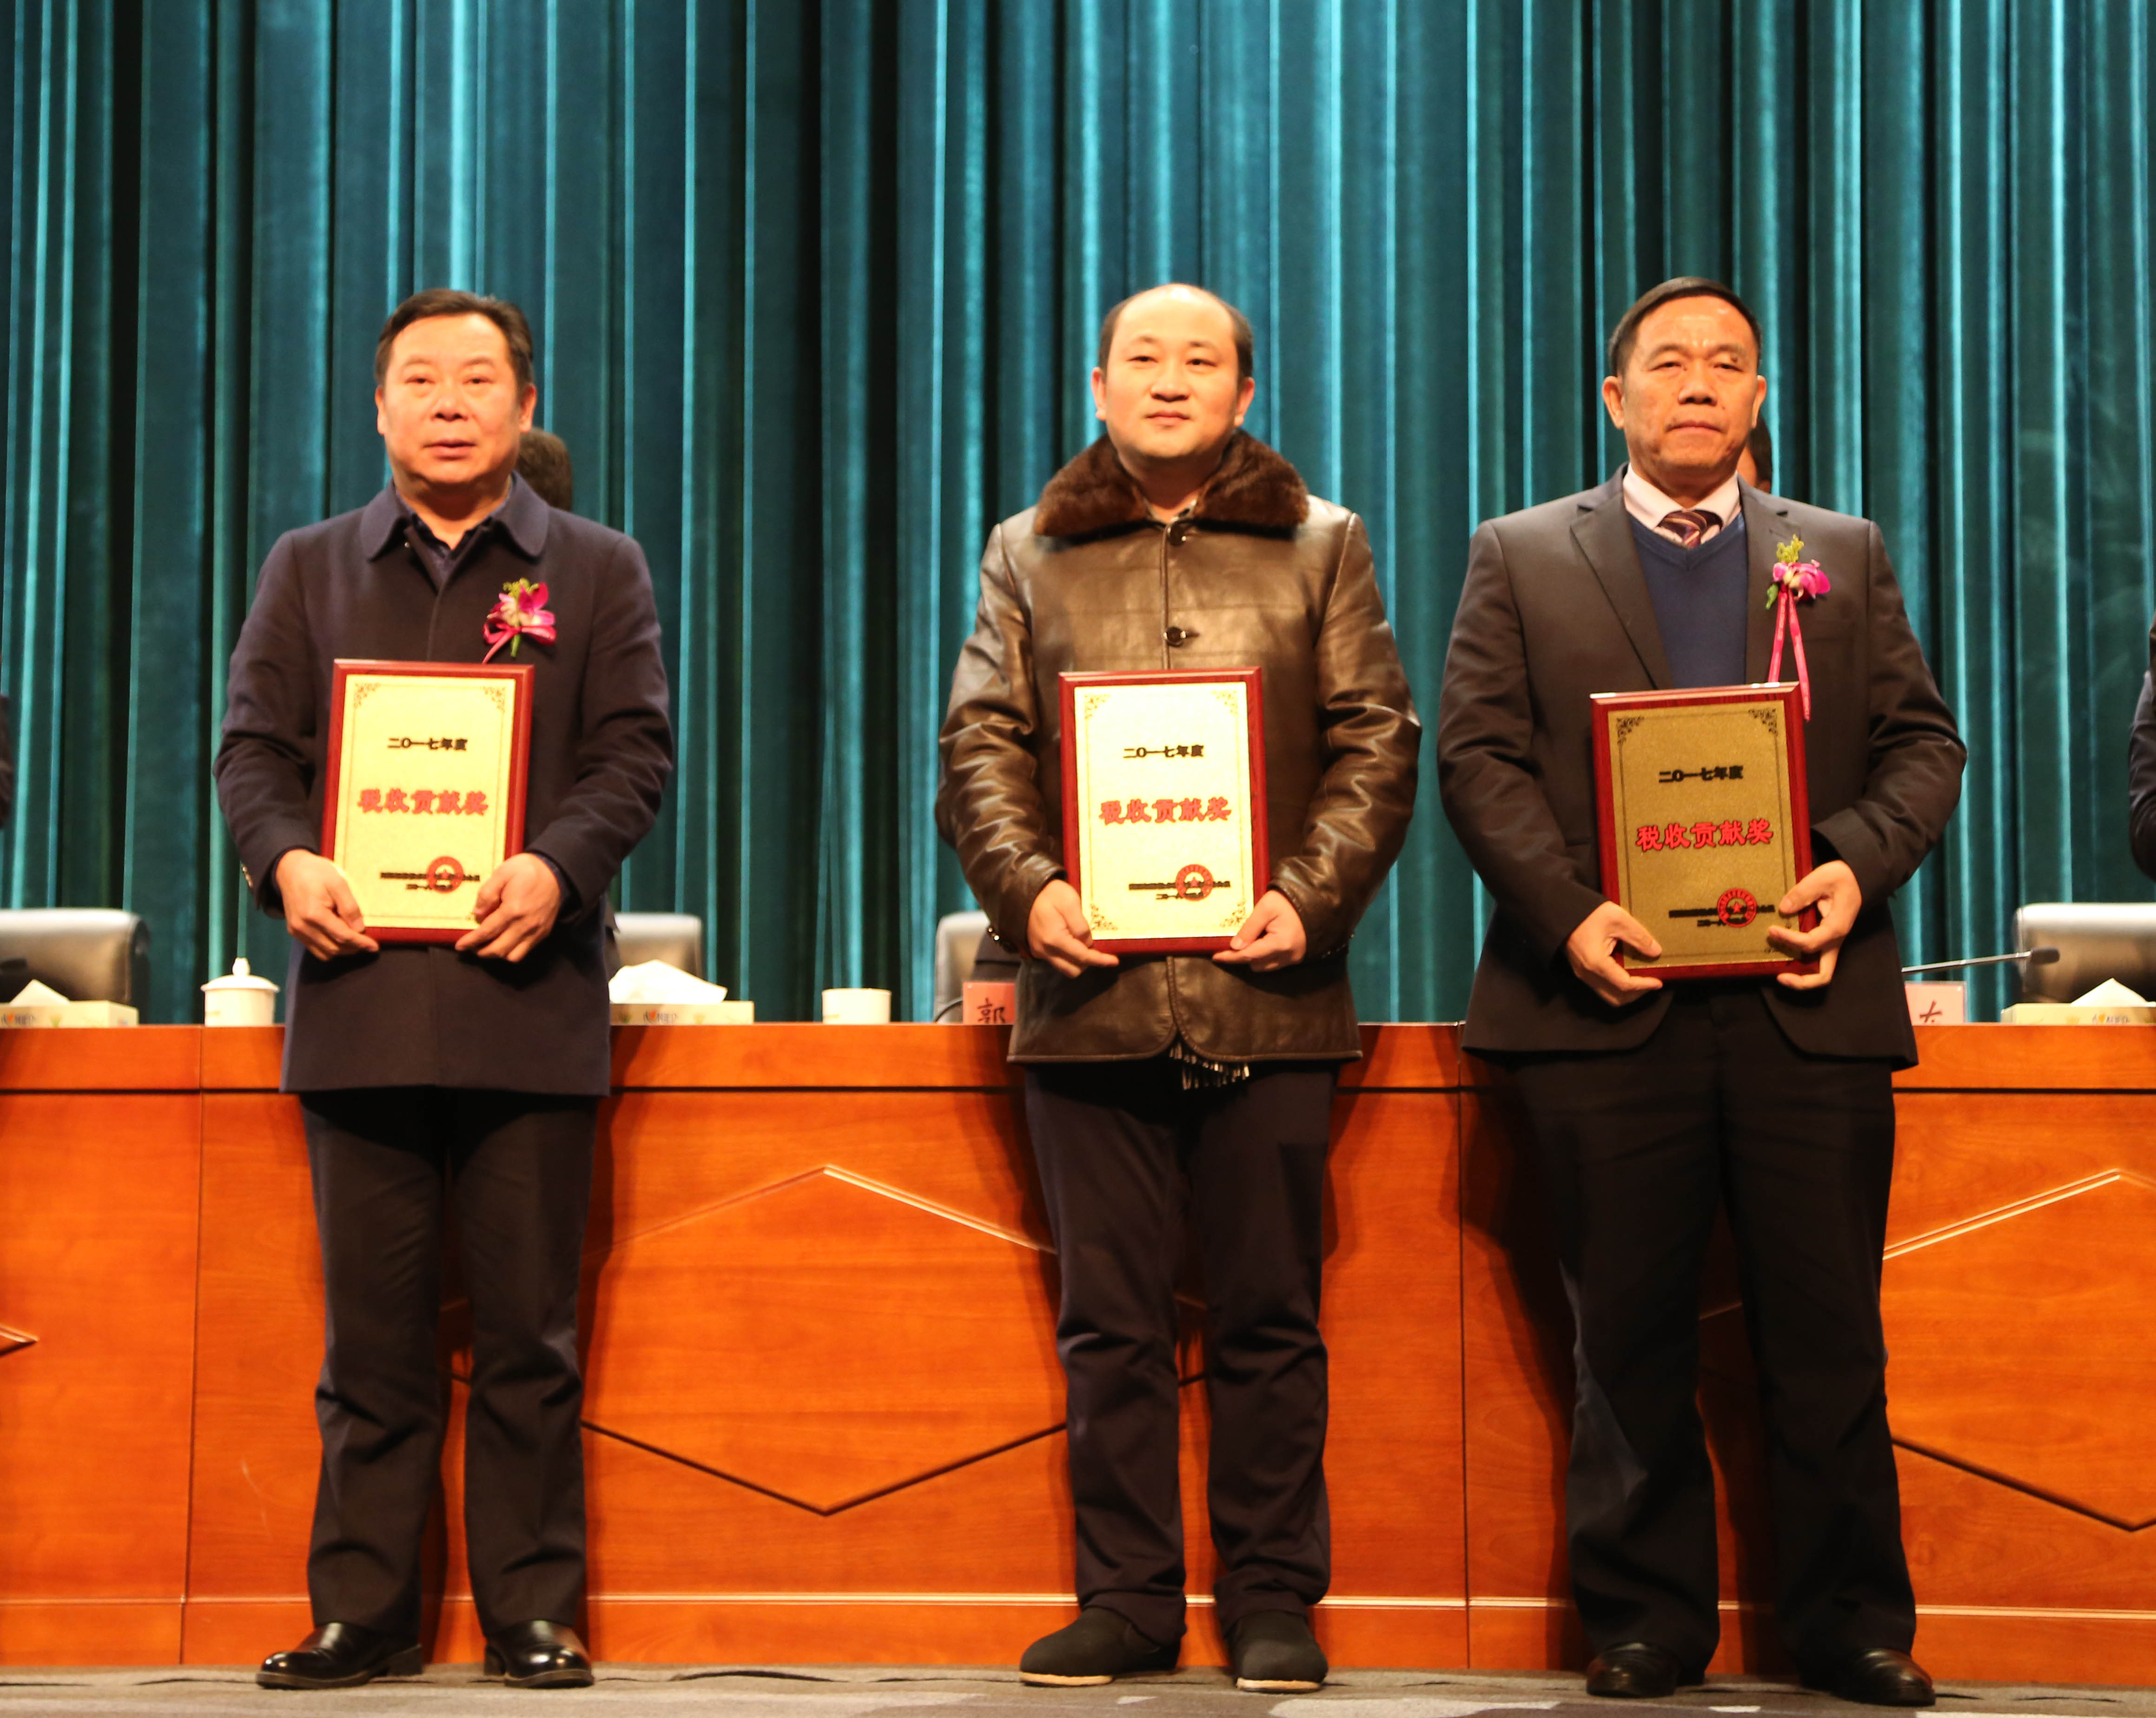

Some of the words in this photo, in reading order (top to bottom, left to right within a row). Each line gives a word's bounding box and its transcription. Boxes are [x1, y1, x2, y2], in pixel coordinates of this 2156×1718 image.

[357, 788, 489, 817] 税收贡献奖
[1098, 796, 1231, 826] 税收贡献奖
[1636, 818, 1773, 852] 税收贡献奖
